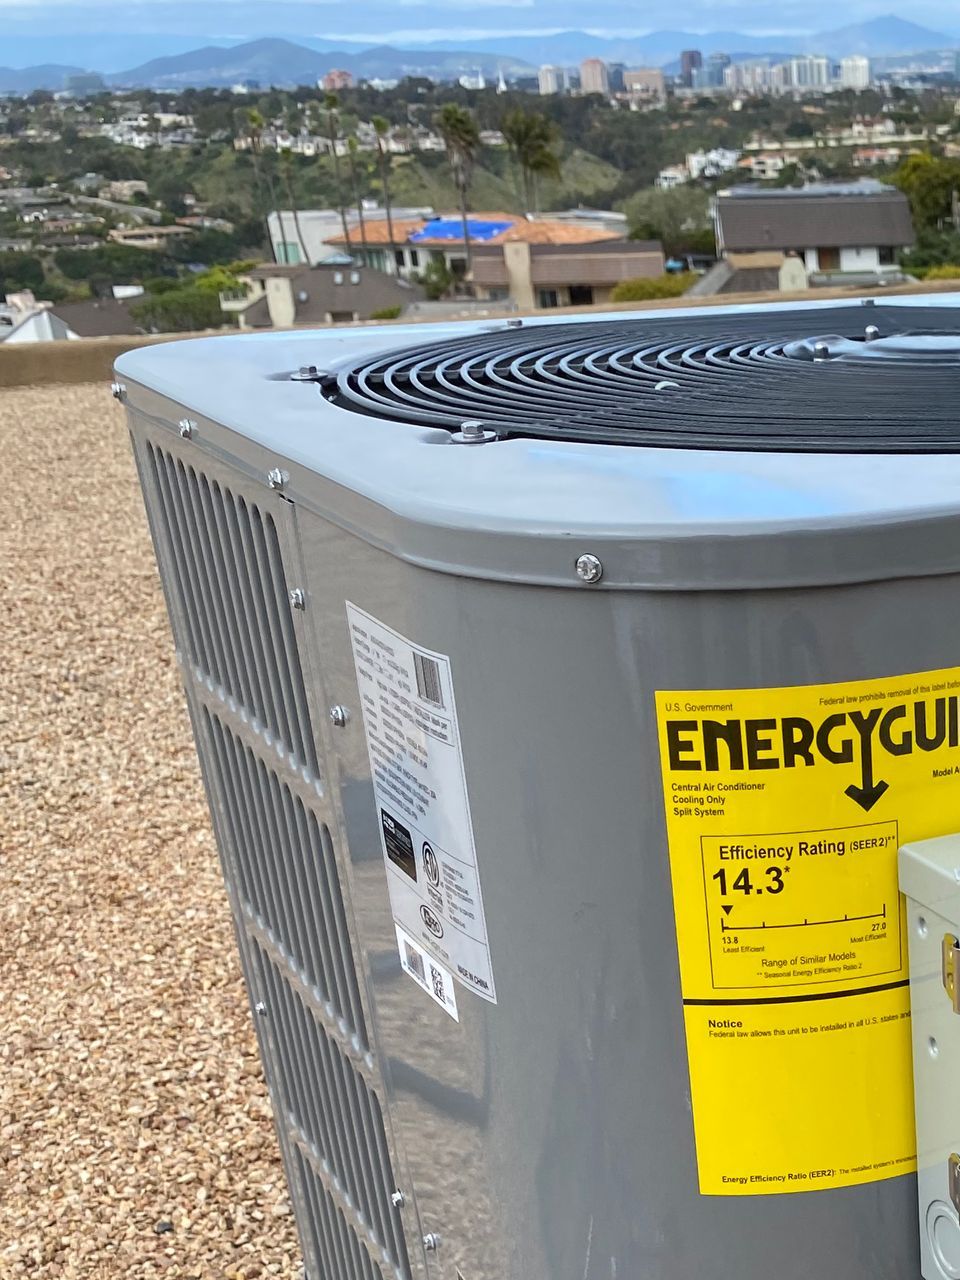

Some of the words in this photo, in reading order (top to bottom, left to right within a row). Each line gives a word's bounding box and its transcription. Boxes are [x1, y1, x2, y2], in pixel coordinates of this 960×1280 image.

[819, 696, 845, 706] Federal
[845, 695, 858, 704] law
[858, 691, 886, 704] prohibits
[887, 687, 912, 699] removal
[912, 685, 919, 695] of
[919, 684, 930, 694] this
[931, 681, 946, 692] label
[665, 703, 682, 712] U.S.
[684, 702, 733, 712] Government
[932, 767, 953, 779] Model
[671, 782, 701, 792] Central
[702, 782, 715, 792] Air
[716, 782, 765, 792] Conditioner
[672, 795, 704, 806] Cooling
[706, 795, 726, 806] Only
[673, 807, 692, 818] Split
[694, 807, 725, 818] System
[719, 844, 794, 861] Efficiency
[798, 839, 845, 857] Rating
[871, 922, 887, 932] 27.0
[722, 936, 739, 945] 13.8
[850, 935, 864, 945] Most
[864, 931, 887, 942] Efficient
[722, 945, 743, 954] Least
[743, 945, 765, 953] Efficient
[761, 958, 788, 969] Range
[790, 956, 798, 966] of
[799, 953, 827, 965] Similar
[828, 951, 856, 962] Models
[763, 969, 792, 979] Seasonal
[792, 968, 813, 978] Energy
[814, 966, 842, 976] Efficiency
[842, 963, 857, 973] Ratio
[708, 1019, 743, 1028] Notice
[708, 1030, 735, 1038] Federal
[736, 1030, 749, 1038] law
[750, 1028, 772, 1037] allows
[773, 1027, 786, 1036] this
[787, 1027, 800, 1035] unit
[801, 1026, 809, 1034] to
[809, 1025, 818, 1034] be
[819, 1022, 847, 1033] installed
[848, 1021, 854, 1029] in
[855, 1019, 864, 1028] all
[864, 1016, 879, 1027] U.S.
[880, 1013, 899, 1024] states
[722, 1175, 748, 1185] Energy
[749, 1173, 786, 1183] Efficiency
[787, 1172, 807, 1181] Ratio
[808, 1169, 836, 1181] (EER2):
